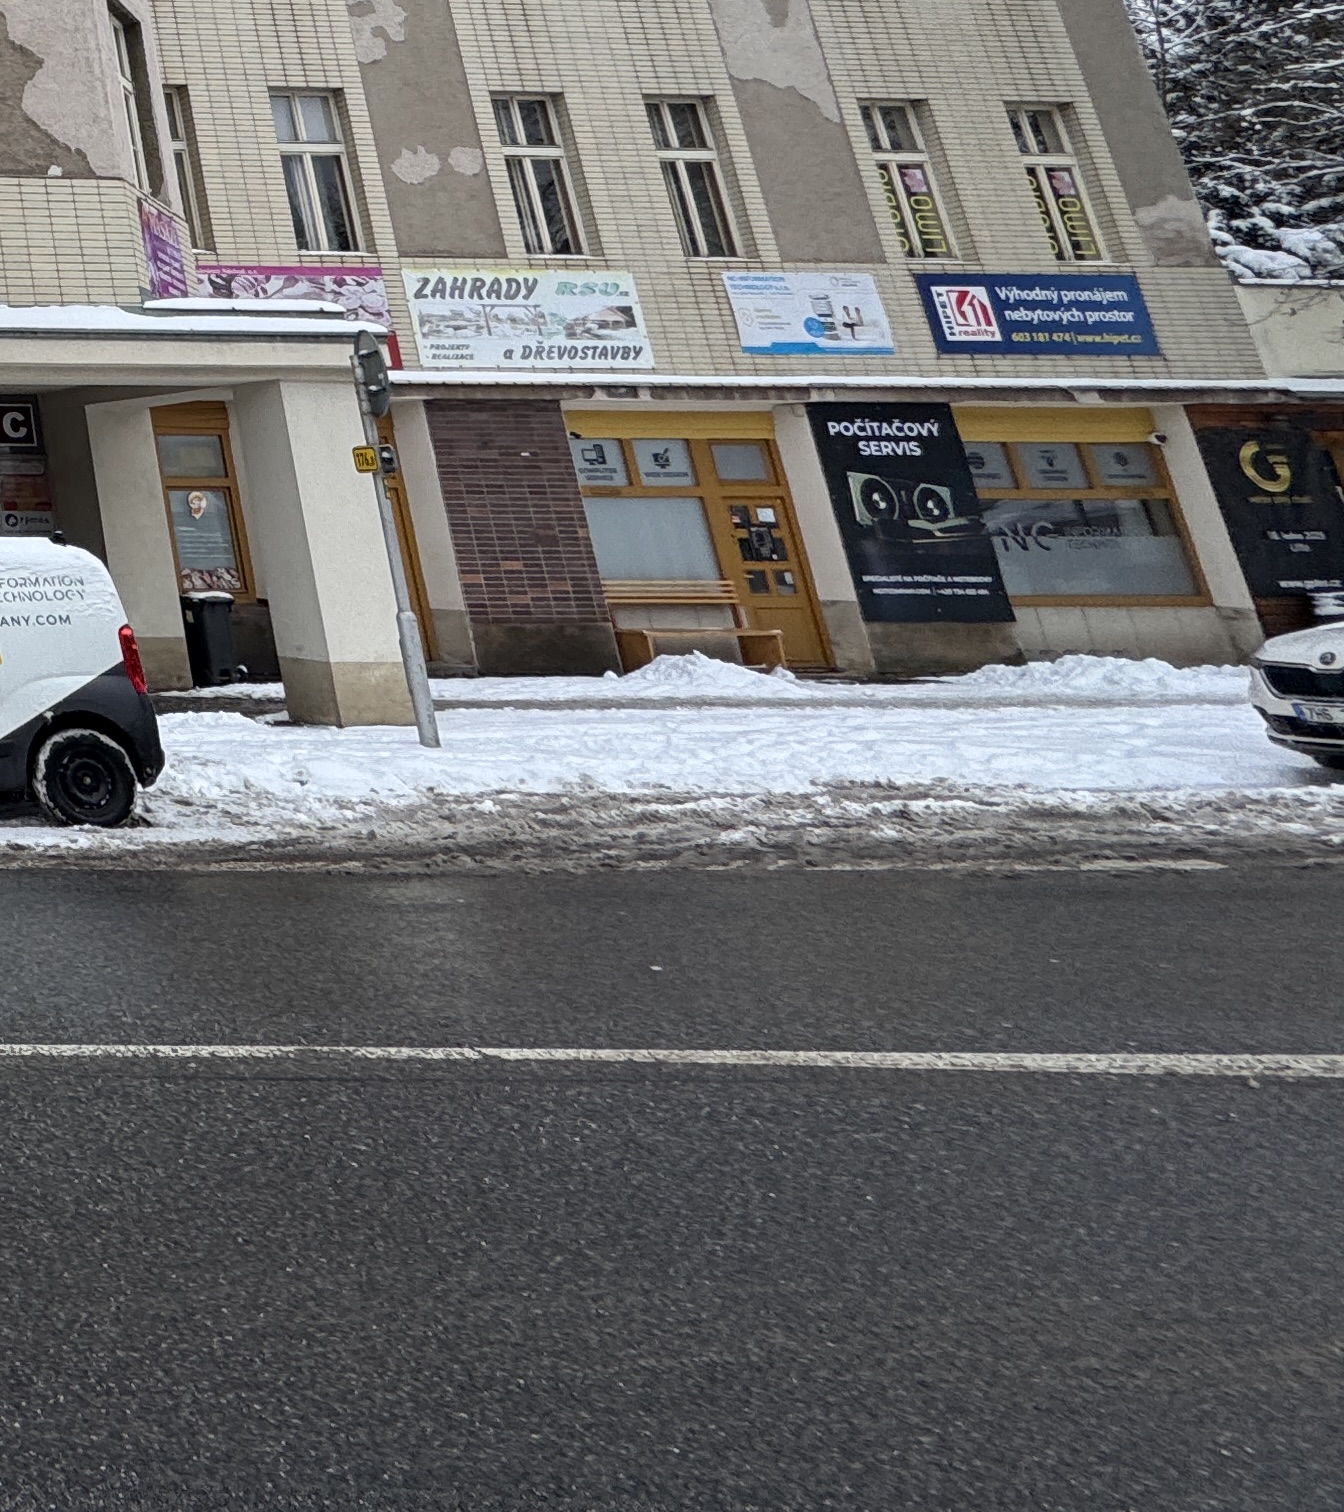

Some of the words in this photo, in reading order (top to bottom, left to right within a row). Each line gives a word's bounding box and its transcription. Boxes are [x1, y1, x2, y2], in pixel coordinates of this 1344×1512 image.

[414, 276, 538, 301] ZAHRADY
[995, 286, 1058, 305] Výhodný
[1062, 289, 1129, 305] pronájem
[1004, 307, 1084, 324] nebytových
[1086, 310, 1134, 324] prostor
[958, 328, 995, 339] reality
[502, 348, 514, 360] a
[520, 340, 644, 361] DŘEVOSTAVBY
[2, 411, 27, 438] C
[827, 418, 939, 437] POČÍTAČOVÝ
[858, 441, 922, 456] SERVIS
